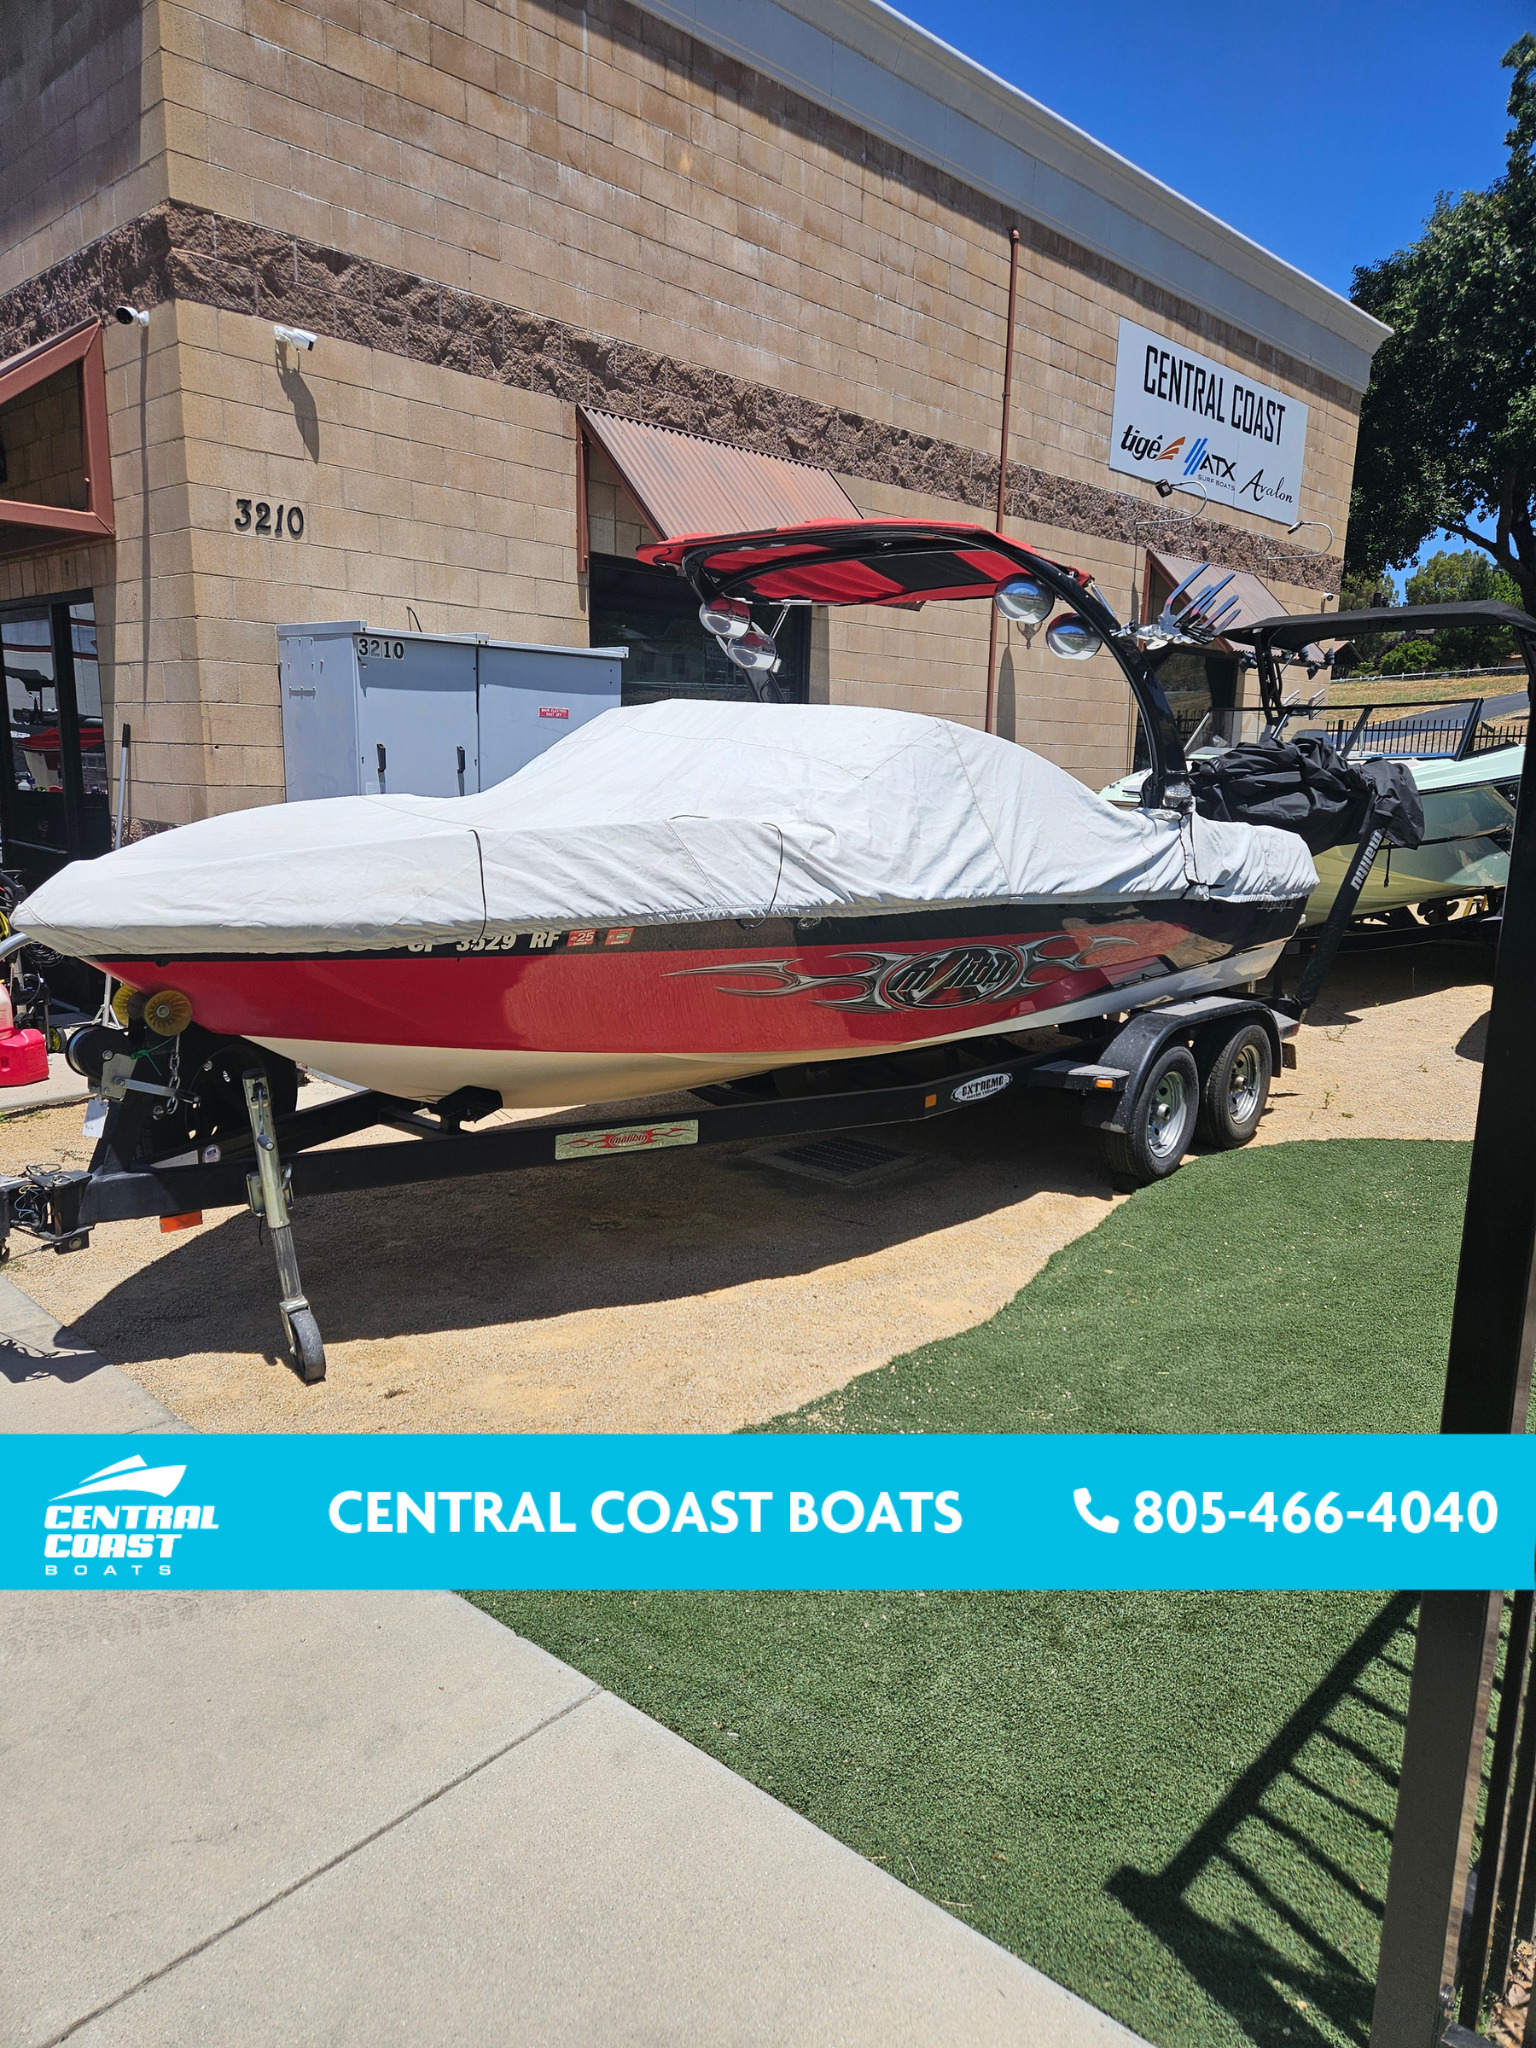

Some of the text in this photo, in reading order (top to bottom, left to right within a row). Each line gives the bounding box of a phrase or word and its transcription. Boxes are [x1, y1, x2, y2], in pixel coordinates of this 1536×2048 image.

[1144, 345, 1286, 446] CENTRAL COAST
[1199, 453, 1237, 481] ATX
[1197, 474, 1236, 492] SURF BOATS
[1239, 468, 1293, 504] Avalon
[235, 498, 304, 535] 3210
[358, 638, 404, 660] 3210
[529, 931, 562, 949] RF
[577, 932, 595, 942] 25
[962, 1076, 1004, 1097] EXTREME
